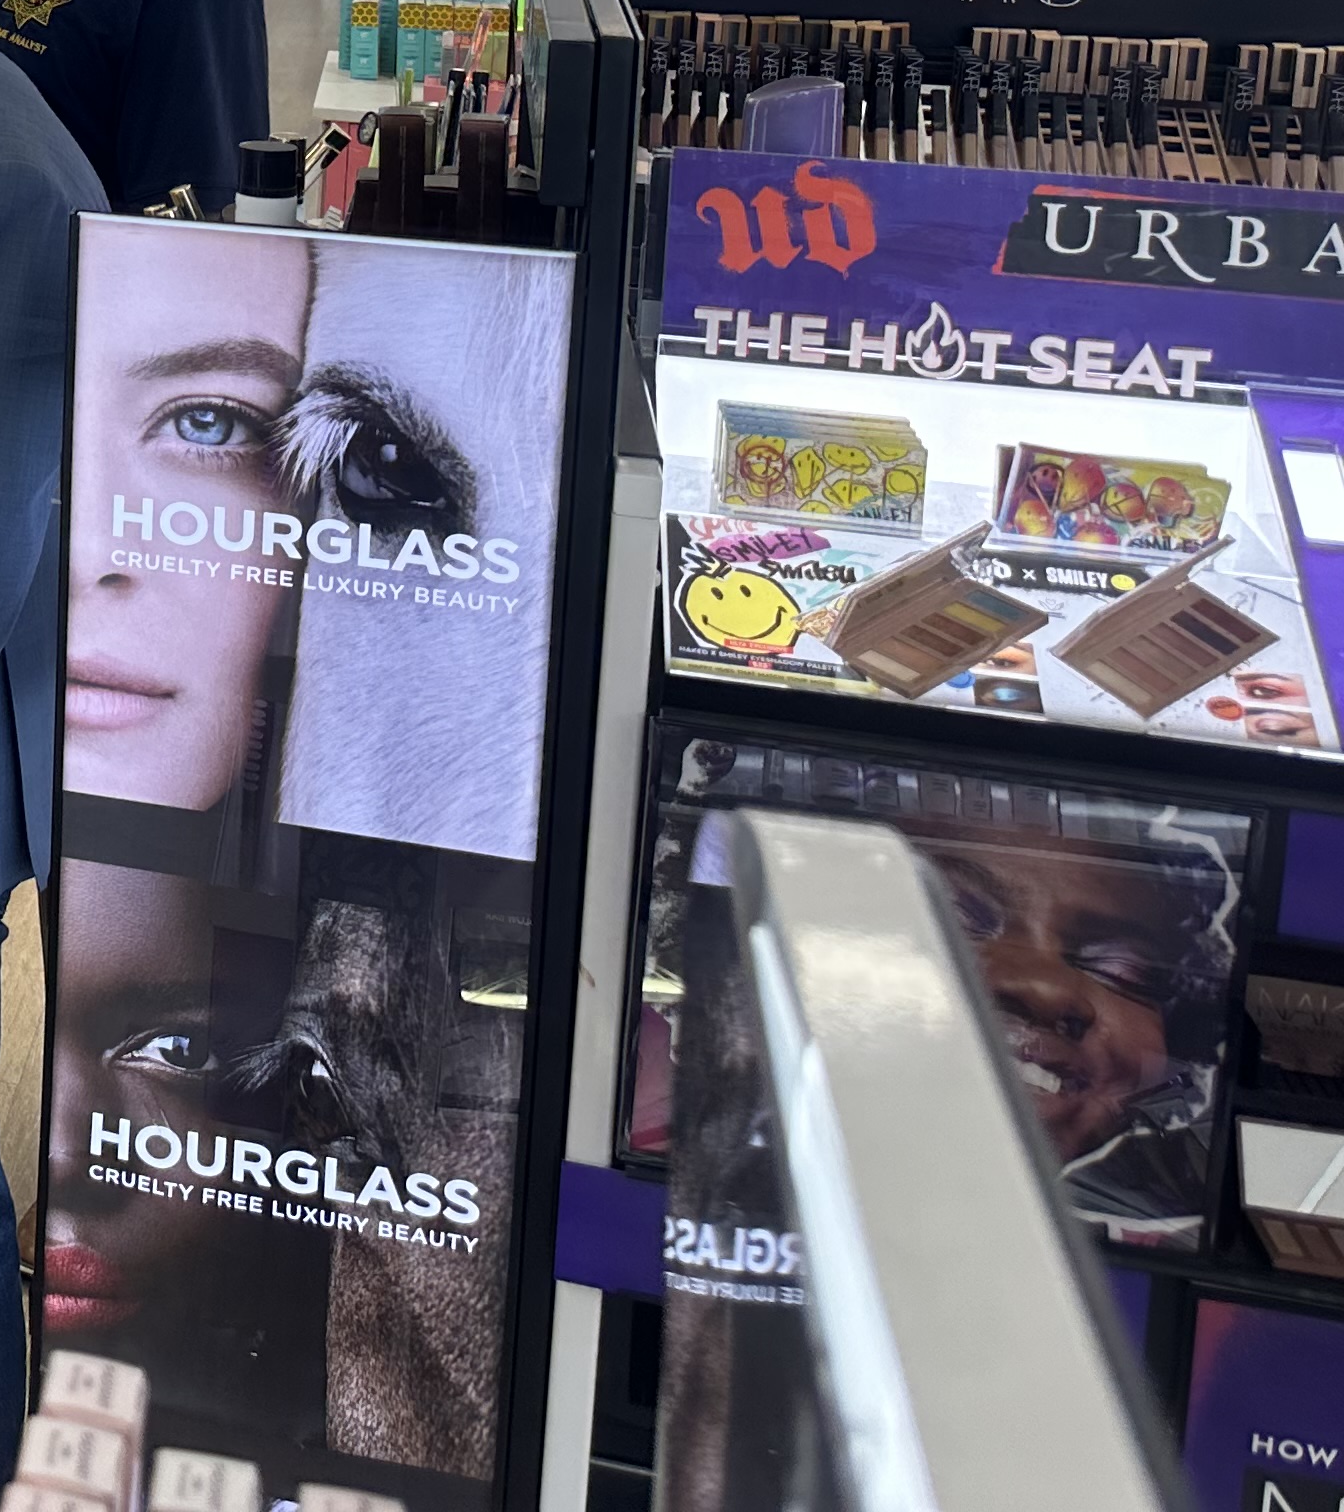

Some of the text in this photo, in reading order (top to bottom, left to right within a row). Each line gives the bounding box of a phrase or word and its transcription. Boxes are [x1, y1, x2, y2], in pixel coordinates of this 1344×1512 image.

[9, 33, 48, 55] ANALYST
[1042, 201, 1344, 283] URBA
[693, 306, 827, 364] THE
[1026, 334, 1213, 398] SEAT
[112, 494, 521, 584] HOURGLASS
[111, 549, 520, 614] CRUELTY FREE LUXURY BEAUTY
[1046, 566, 1109, 590] SMILEY
[678, 646, 709, 656] NAKED
[718, 650, 747, 660] SMILEY
[750, 654, 805, 667] EYESHADOW
[806, 662, 842, 672] PALETTE
[90, 1112, 480, 1224] HOURGLASS
[88, 1164, 479, 1254] CRUELTY FREE LUXURY BEAUTY
[1252, 1433, 1338, 1469] HOW
